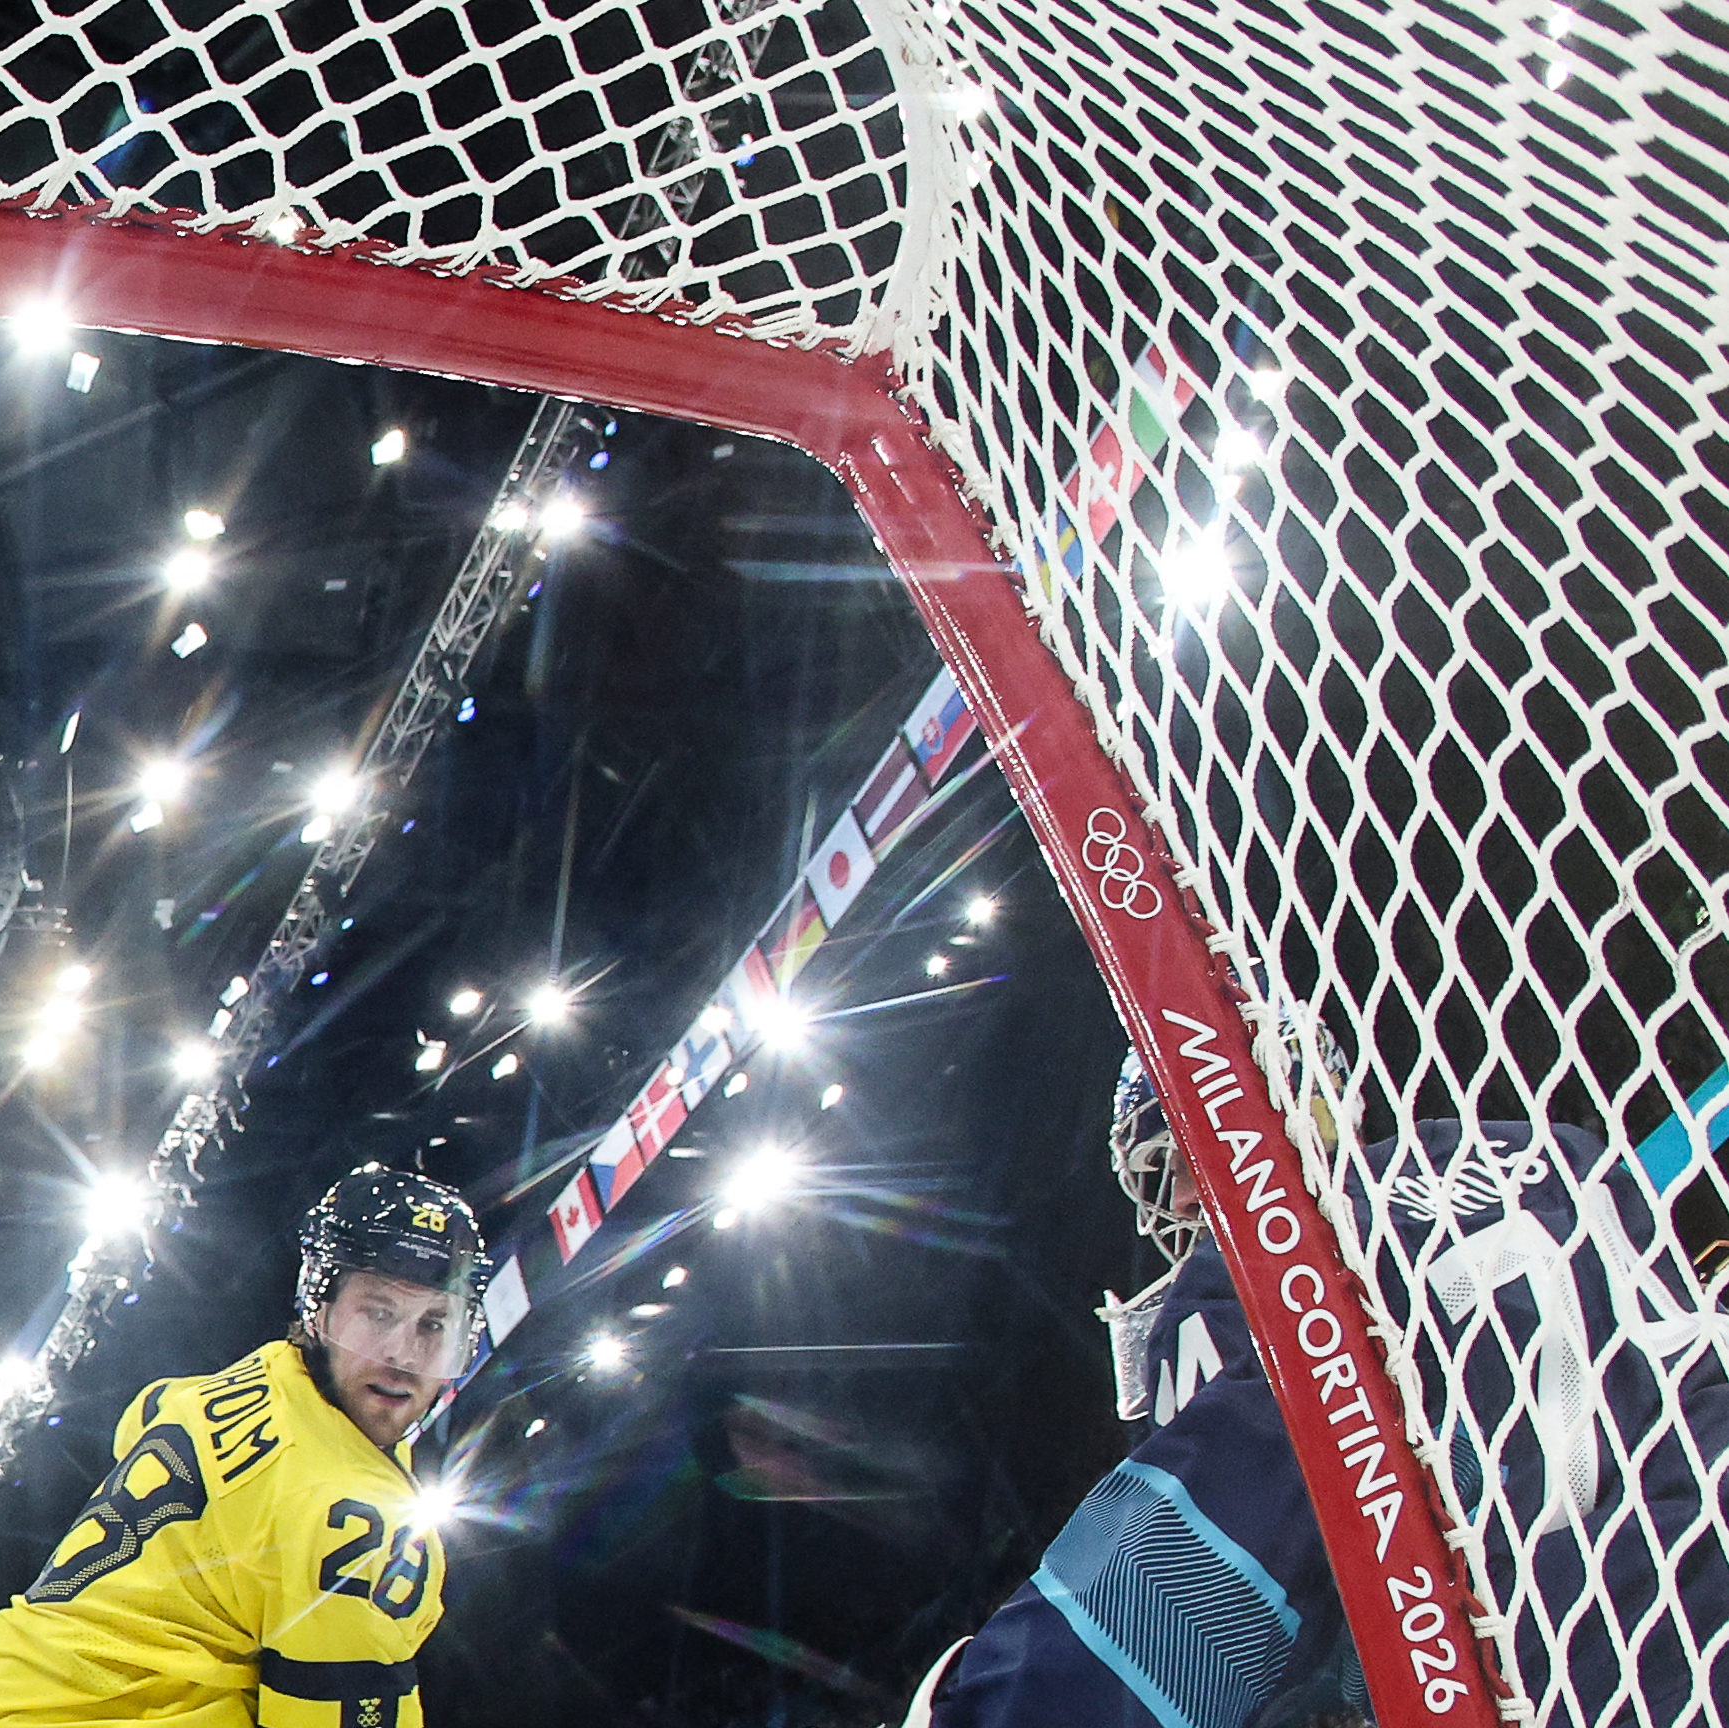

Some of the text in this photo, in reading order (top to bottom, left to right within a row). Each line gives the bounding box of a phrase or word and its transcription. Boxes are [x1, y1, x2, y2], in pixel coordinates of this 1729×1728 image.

[412, 1204, 448, 1233] 28
[1161, 1008, 1301, 1255] MILANO
[1280, 1264, 1404, 1564] CORTINA
[1386, 1566, 1469, 1714] 2026
[319, 1498, 430, 1621] 28
